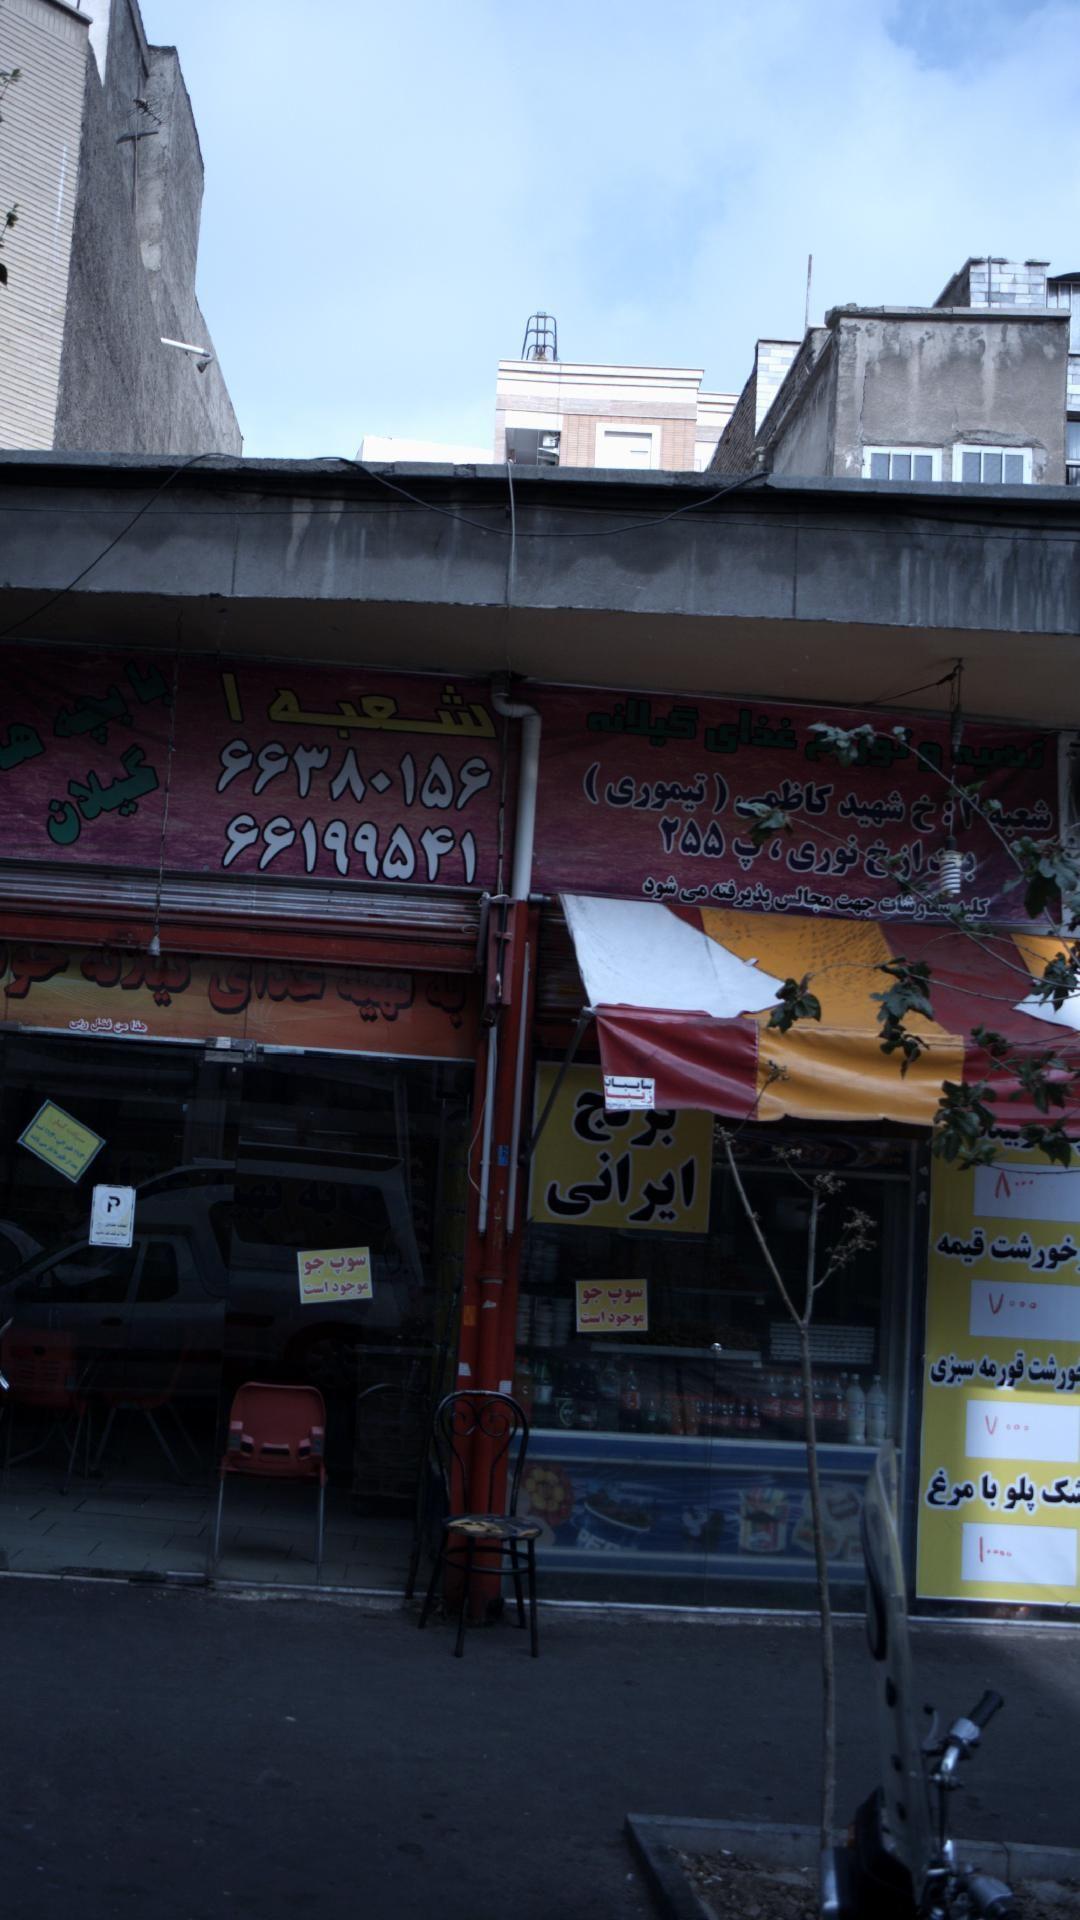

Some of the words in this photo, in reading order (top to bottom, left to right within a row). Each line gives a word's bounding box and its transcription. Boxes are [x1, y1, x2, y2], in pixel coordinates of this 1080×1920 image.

[267, 683, 496, 740] شعبه
[586, 697, 699, 747] گیلانه
[703, 708, 798, 753] غذای
[216, 738, 491, 810] ۶۶۳۸۰۱۵۶
[47, 743, 159, 845] گیلان
[837, 790, 906, 828] شهید
[911, 795, 936, 833] خ
[222, 813, 477, 884] ۶۶۱۹۹۵۴۱
[659, 816, 727, 859] ۲۵۵
[732, 836, 764, 871] پ
[787, 834, 858, 876] نوری
[929, 847, 975, 882] بد
[643, 875, 679, 900] شود
[680, 884, 708, 904] می
[710, 878, 775, 911] پذیرفته
[772, 886, 833, 913] مجالس
[834, 895, 875, 917] جهت
[879, 895, 951, 920] سارشات
[959, 897, 991, 921] کلی
[547, 1151, 696, 1221] ایرانی
[938, 1230, 984, 1263] قیمه
[991, 1235, 1078, 1269] خورشت
[304, 1258, 324, 1275] جو
[330, 1256, 366, 1274] سوپ
[304, 1281, 328, 1295] است
[582, 1288, 602, 1304] جو
[607, 1288, 643, 1304] سوپ
[581, 1311, 605, 1323] است
[931, 1356, 974, 1383] سبزی
[979, 1352, 1024, 1387] قورمه
[1028, 1356, 1080, 1390] ورشت
[927, 1470, 974, 1506] مرغ
[981, 1475, 997, 1507] با
[1004, 1477, 1034, 1511] پلو
